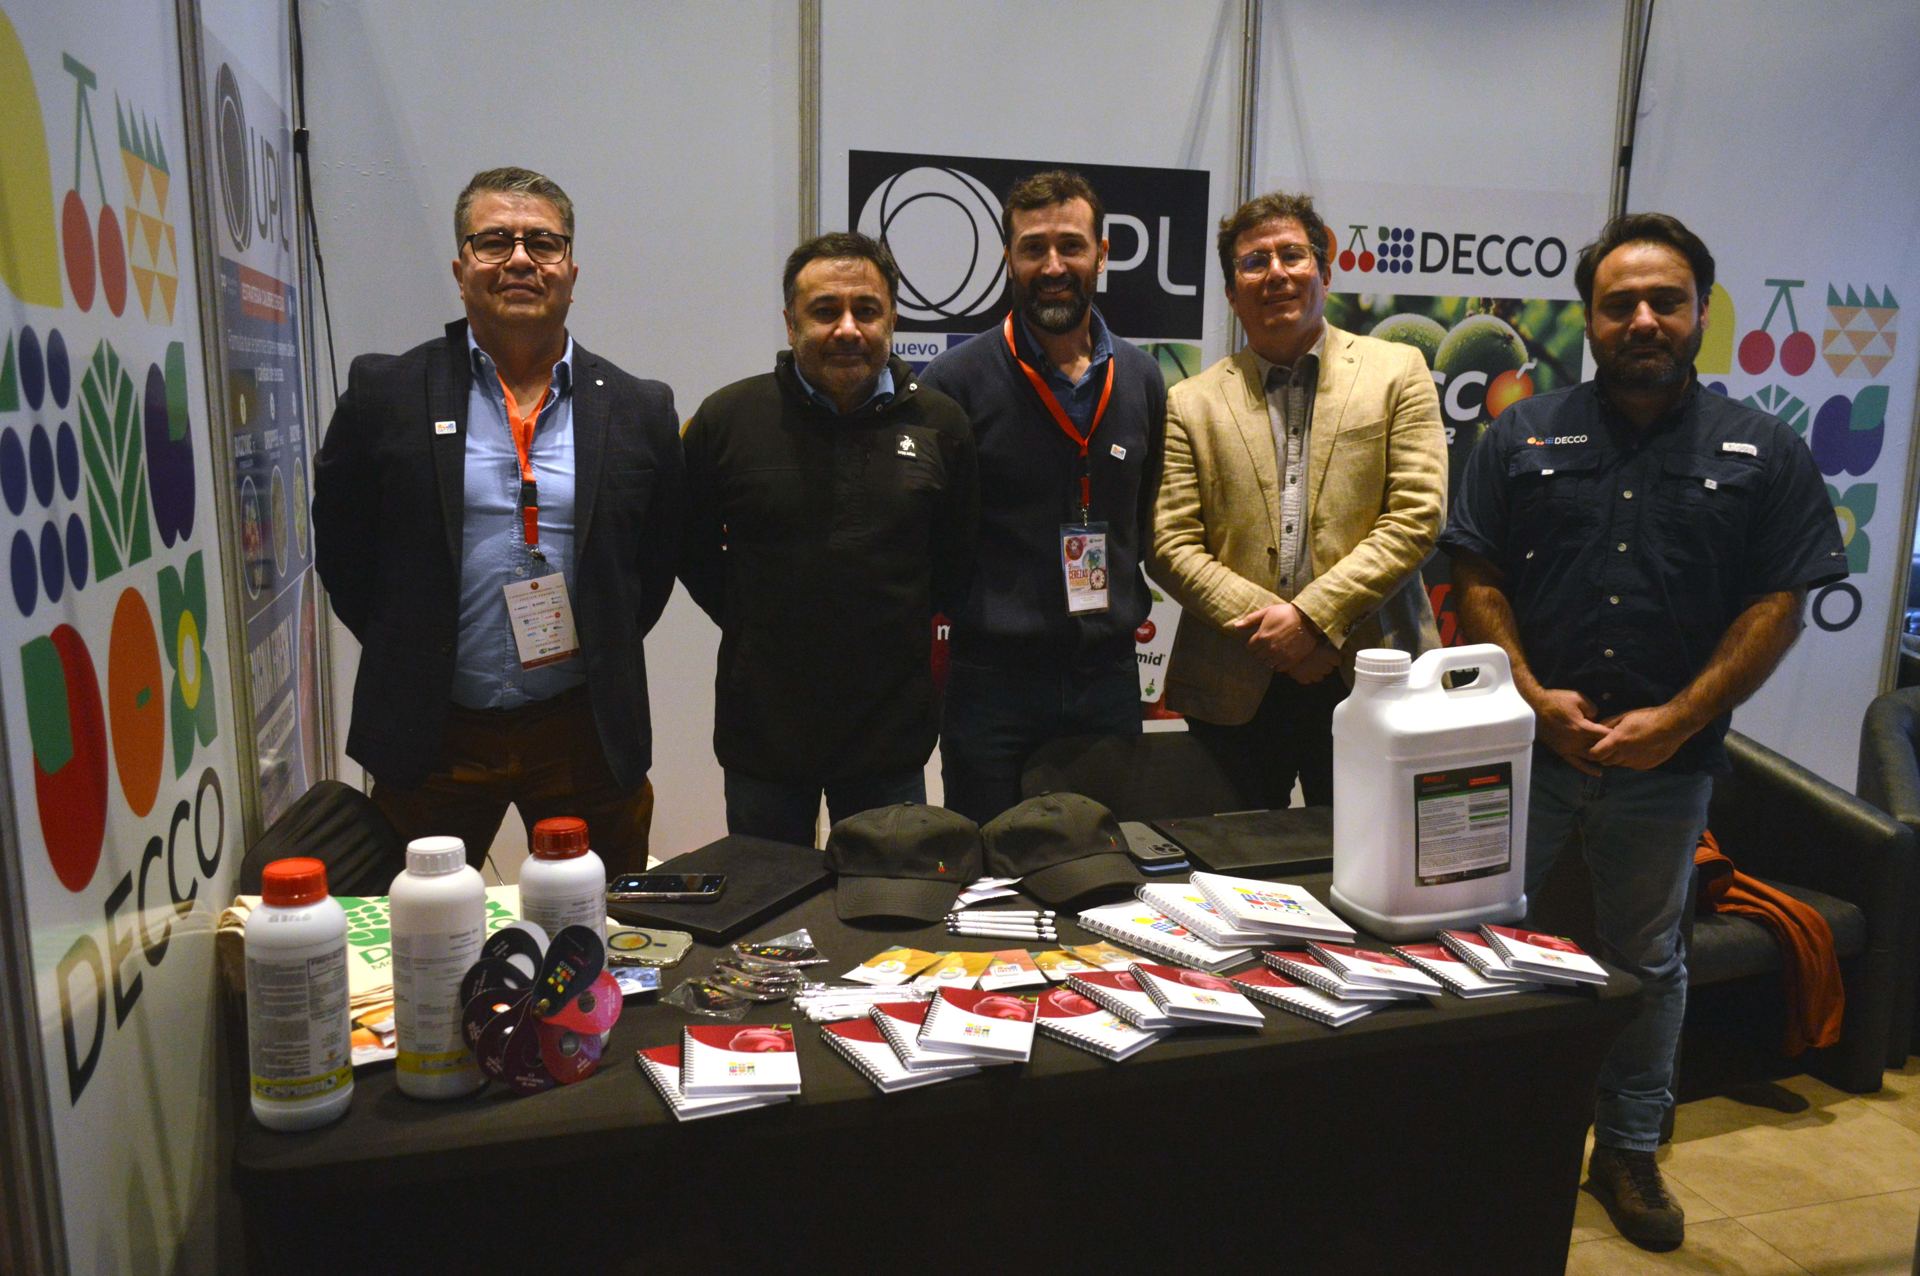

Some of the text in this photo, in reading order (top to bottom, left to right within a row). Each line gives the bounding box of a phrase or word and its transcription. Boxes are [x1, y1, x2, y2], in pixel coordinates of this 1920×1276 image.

[249, 127, 290, 254] UPL
[1098, 213, 1197, 297] PL
[1419, 231, 1568, 278] DECCO
[895, 343, 939, 356] uevo
[1554, 434, 1588, 445] DECCO
[1136, 651, 1164, 666] mid
[56, 766, 225, 1108] DECCO
